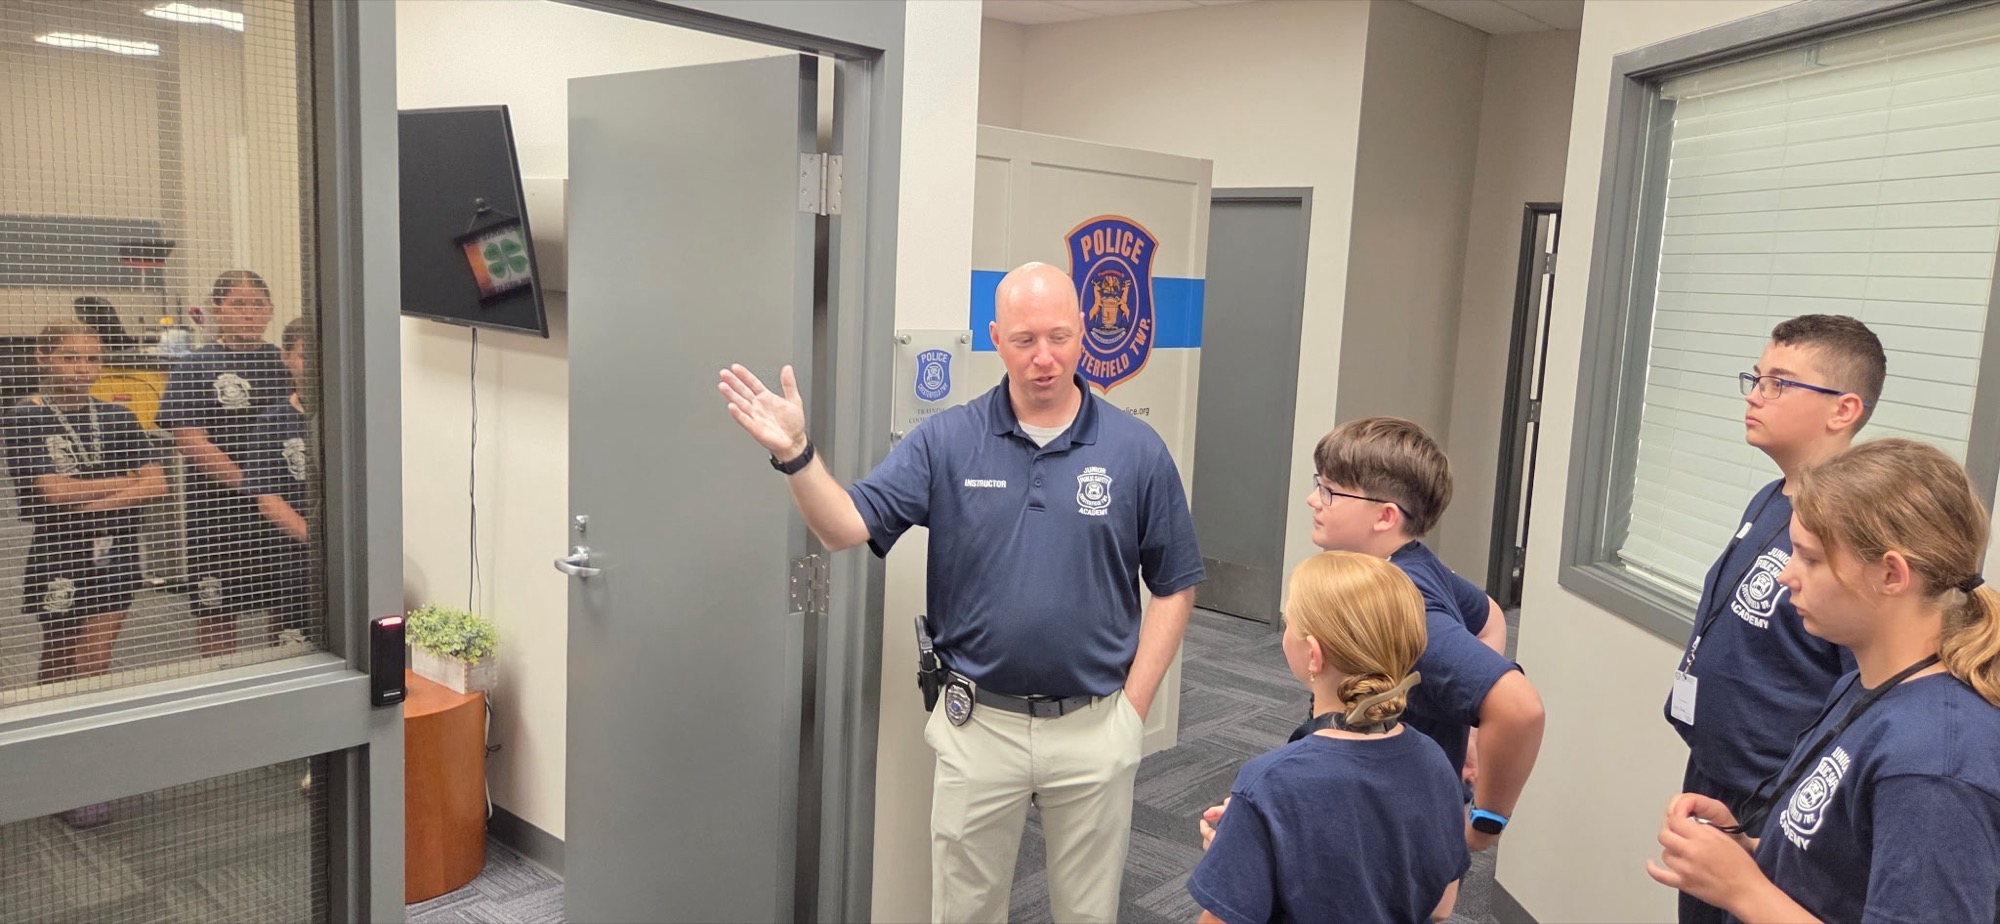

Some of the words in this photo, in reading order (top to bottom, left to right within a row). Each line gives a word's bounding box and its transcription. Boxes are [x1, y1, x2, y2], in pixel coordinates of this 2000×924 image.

[1080, 227, 1145, 265] POLICE
[1129, 318, 1151, 357] TWP.
[921, 352, 949, 364] POLICE
[964, 478, 1007, 489] INSTRUCTOR
[1078, 507, 1108, 516] ACADEMY
[1767, 547, 1791, 565] JUNIO
